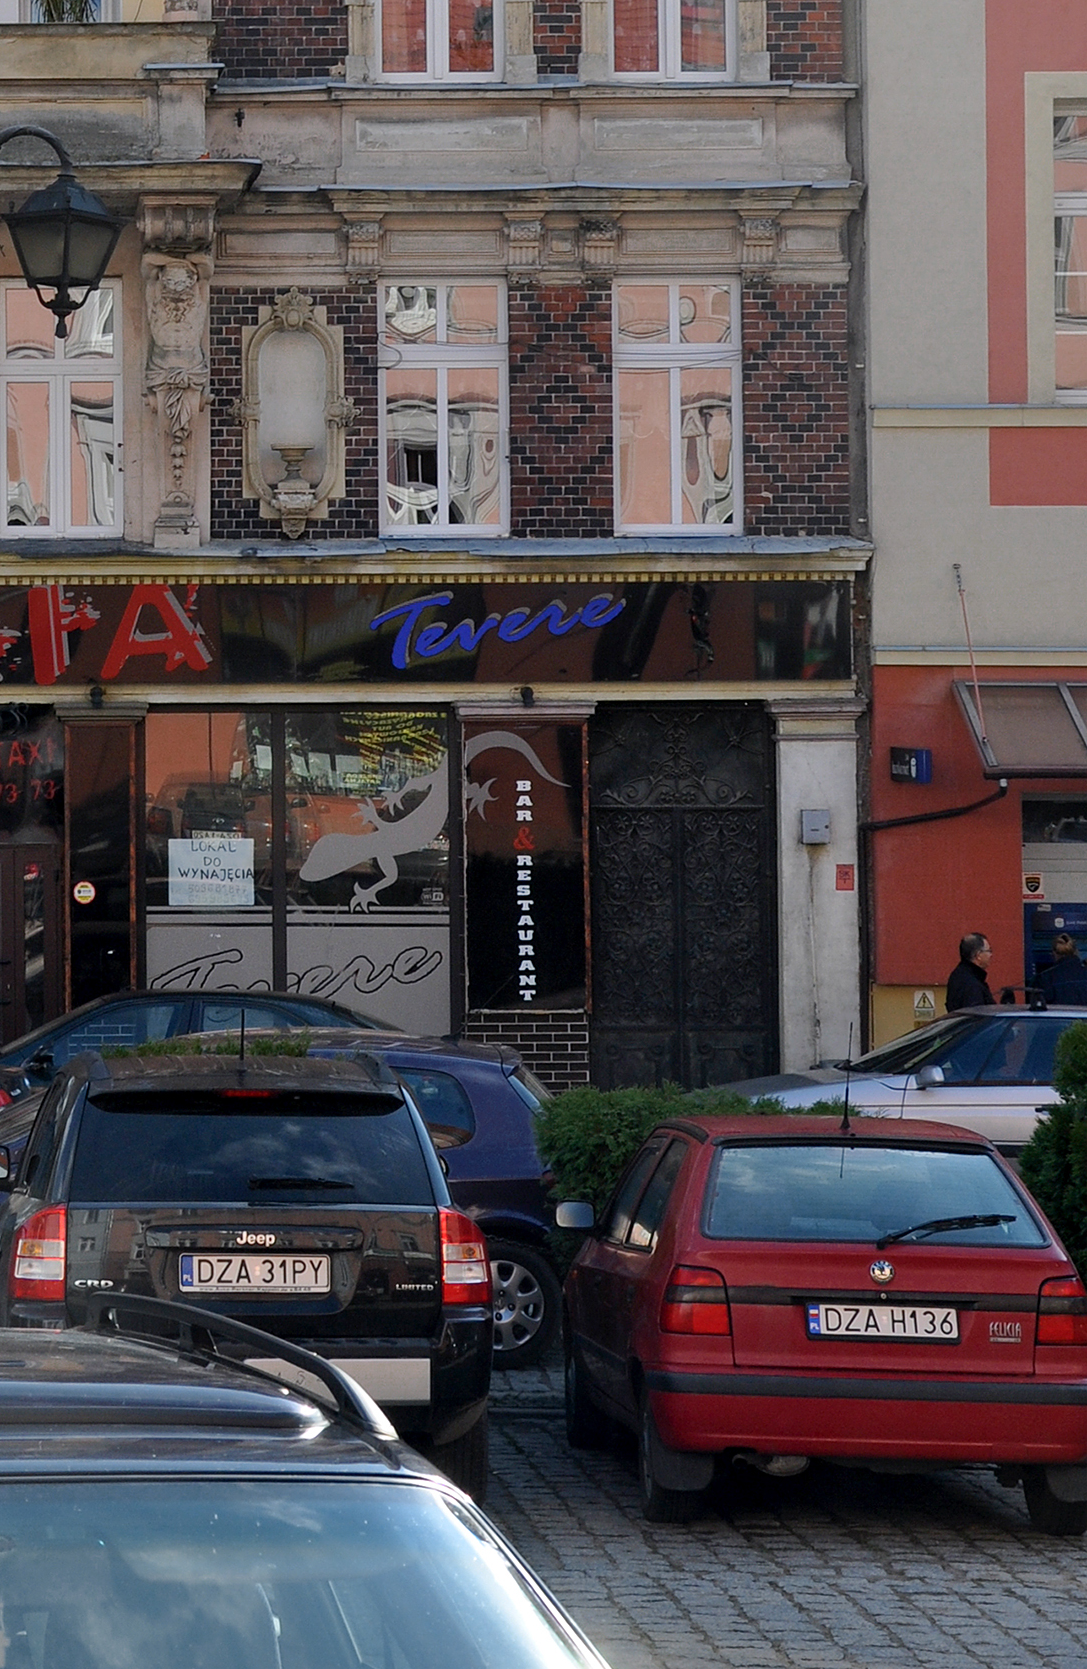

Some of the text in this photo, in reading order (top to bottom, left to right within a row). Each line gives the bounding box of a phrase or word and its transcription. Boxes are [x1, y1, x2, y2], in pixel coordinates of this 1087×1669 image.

[370, 591, 627, 669] Tevere
[516, 780, 533, 821] BAR
[191, 840, 237, 852] LOKAL
[203, 856, 221, 867] DO
[178, 867, 254, 882] WYNAJĘCIA
[516, 855, 536, 1001] RESTAURANT
[236, 1231, 276, 1247] Jeep
[198, 1259, 252, 1284] DZA
[261, 1259, 323, 1284] 31PY
[74, 1279, 114, 1288] CRD
[395, 1283, 434, 1291] LIMITED
[824, 1308, 880, 1332] DZA
[891, 1309, 953, 1335] H136
[989, 1321, 1022, 1337] FELICIA
